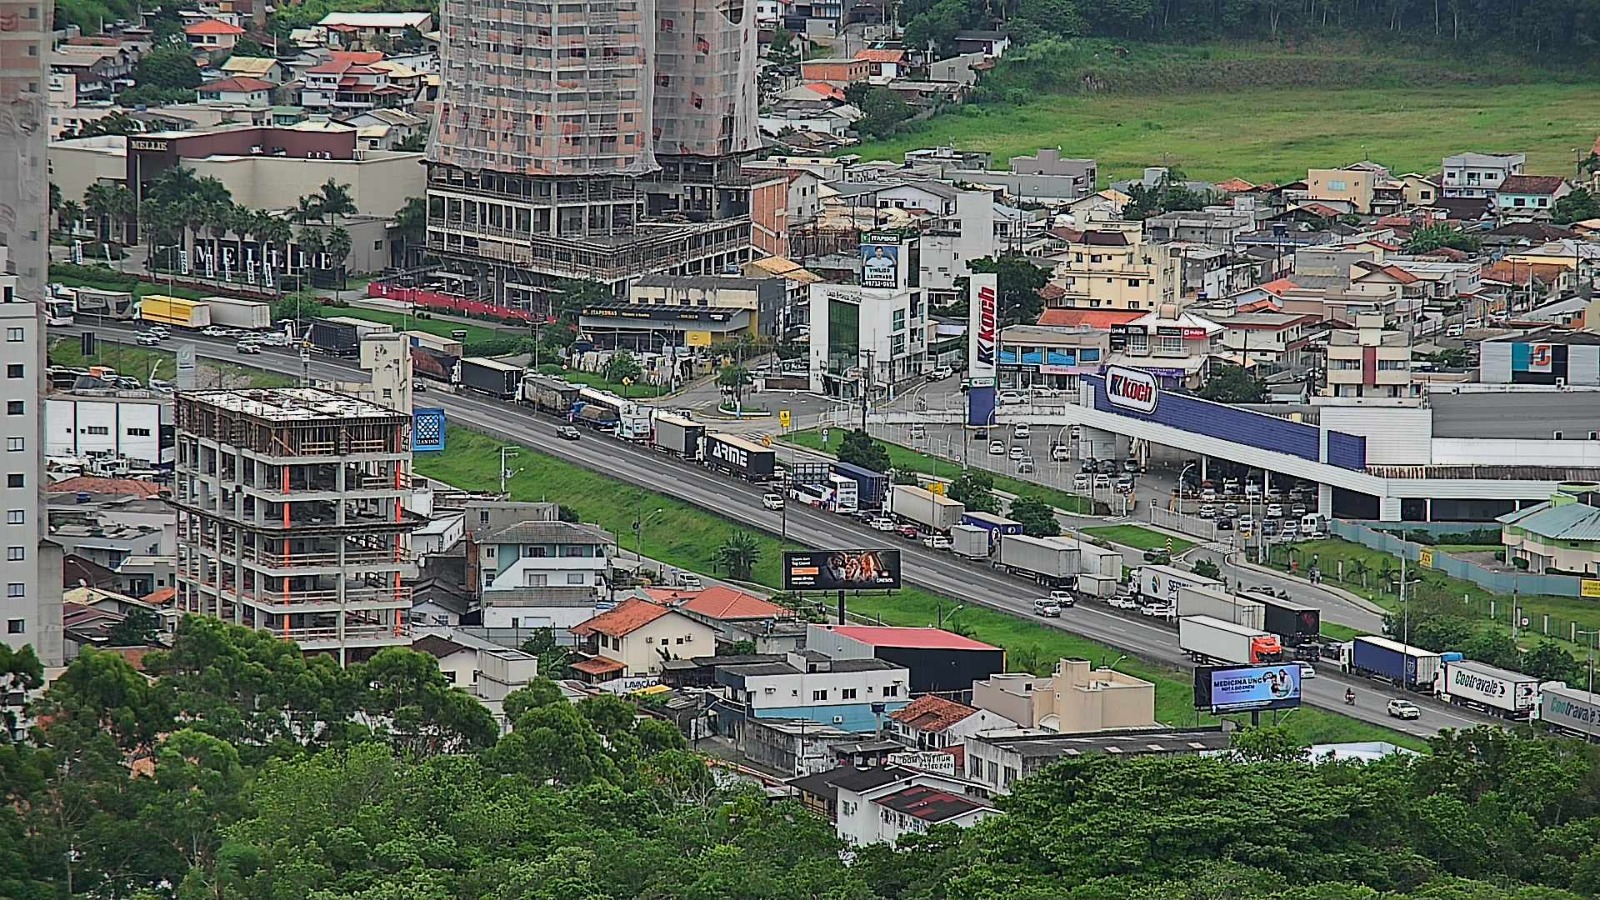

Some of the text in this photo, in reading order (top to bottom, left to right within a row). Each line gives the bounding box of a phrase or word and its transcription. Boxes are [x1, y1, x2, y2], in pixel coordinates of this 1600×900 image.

[131, 141, 168, 151] MELLIE
[1213, 678, 1247, 688] MEDICINA
[1455, 670, 1498, 695] Cootravale
